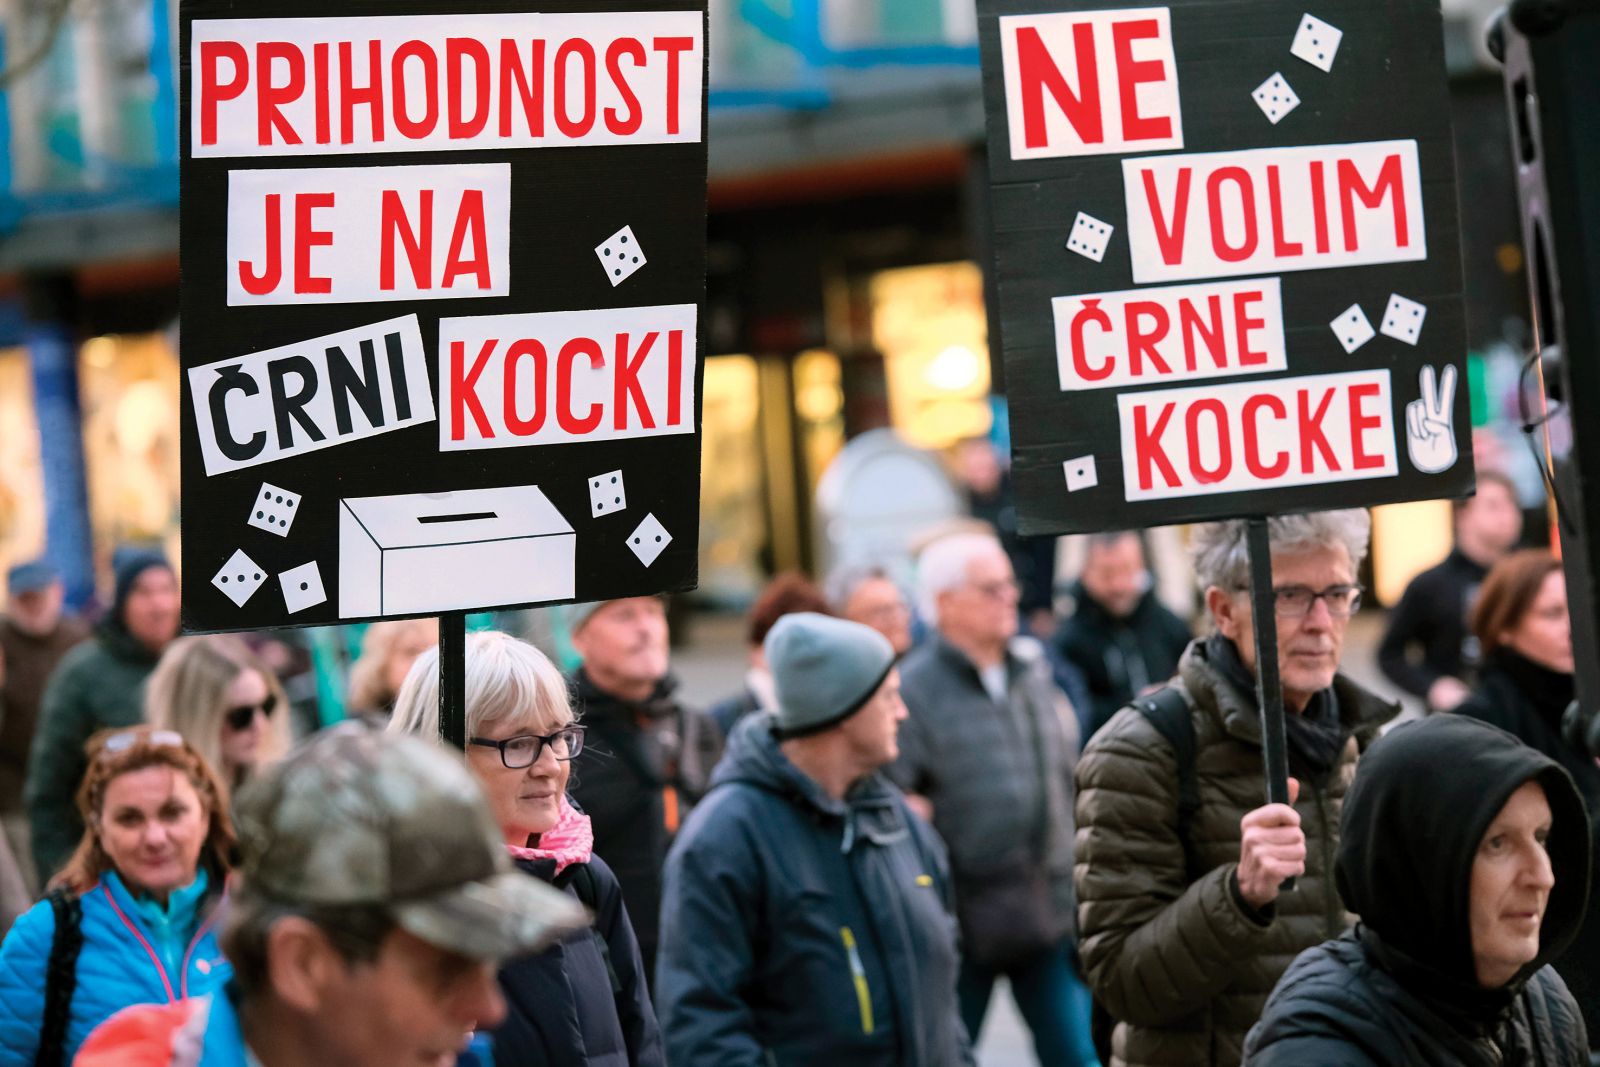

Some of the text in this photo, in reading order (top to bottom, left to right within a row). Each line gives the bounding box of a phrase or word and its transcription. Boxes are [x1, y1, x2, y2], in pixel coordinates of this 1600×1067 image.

[200, 36, 694, 147] PRIHODNOST
[1015, 19, 1173, 149] NE
[238, 189, 492, 296] JE NA
[1140, 153, 1409, 266] VOLIM
[1069, 290, 1269, 382] ČRNE
[207, 329, 683, 462] ČRNI KOCKI
[1133, 382, 1386, 491] KOCKE
